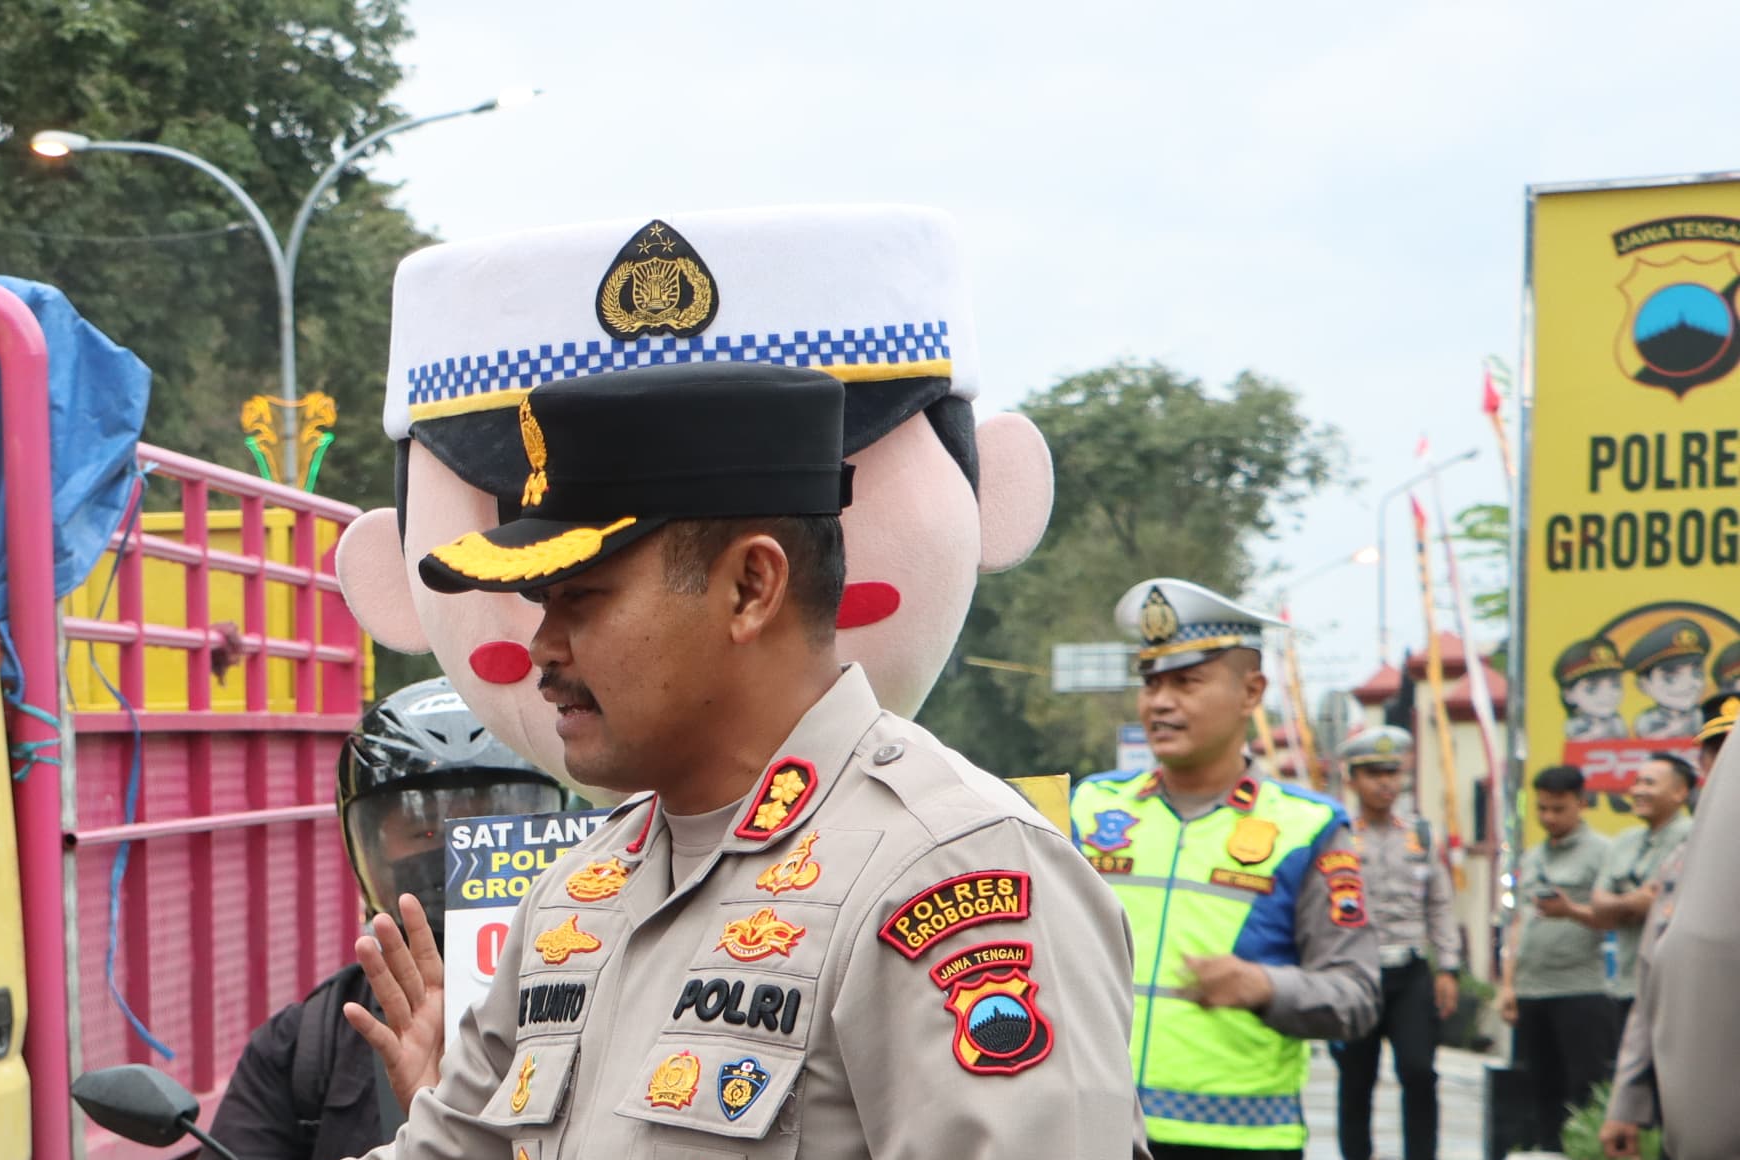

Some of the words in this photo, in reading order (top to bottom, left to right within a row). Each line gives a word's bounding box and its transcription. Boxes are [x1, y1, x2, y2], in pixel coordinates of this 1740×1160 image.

[1618, 224, 1672, 252] JAWA
[452, 822, 513, 850] SAT
[462, 876, 540, 900] GRO
[895, 878, 1014, 937] POLRES
[906, 894, 1018, 949] GROBOGAN
[940, 957, 973, 980] JAWA
[973, 948, 1025, 964] TENGAH
[672, 977, 802, 1035] POLRI
